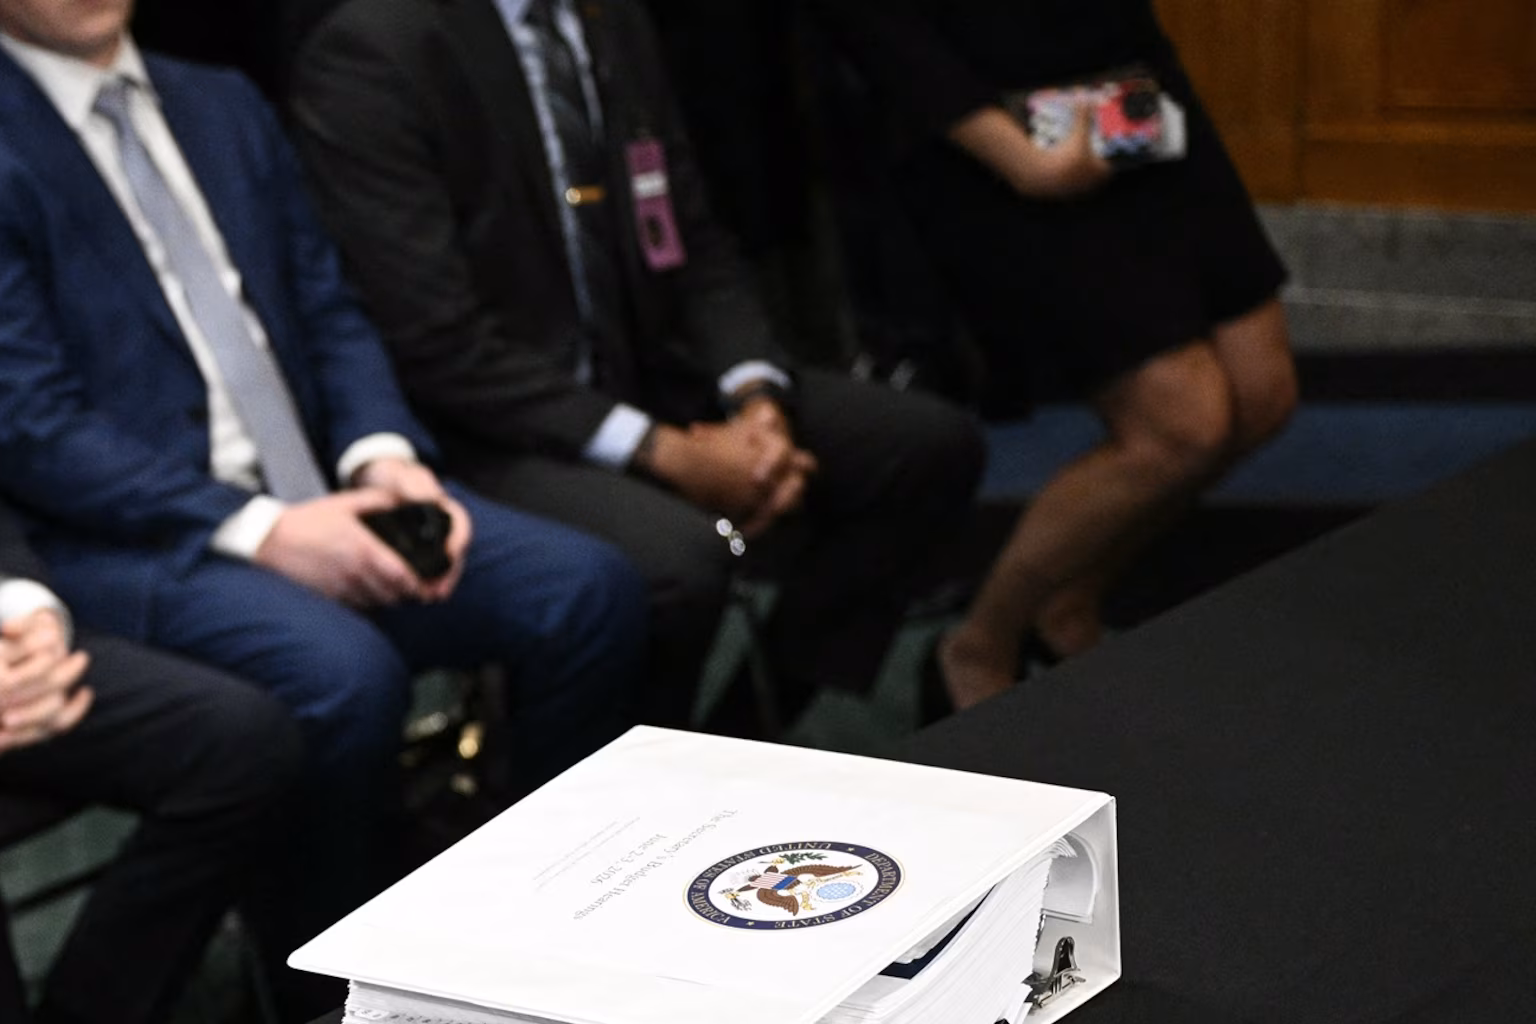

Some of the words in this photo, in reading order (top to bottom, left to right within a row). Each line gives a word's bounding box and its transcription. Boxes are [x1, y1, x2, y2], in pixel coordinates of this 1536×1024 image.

[759, 841, 833, 856] UNITED
[706, 848, 756, 879] STATES
[692, 877, 711, 891] OF
[864, 851, 898, 906] DEPARTMENT
[690, 890, 732, 925] AMERICA
[840, 905, 864, 919] OF
[774, 914, 836, 930] STATE
